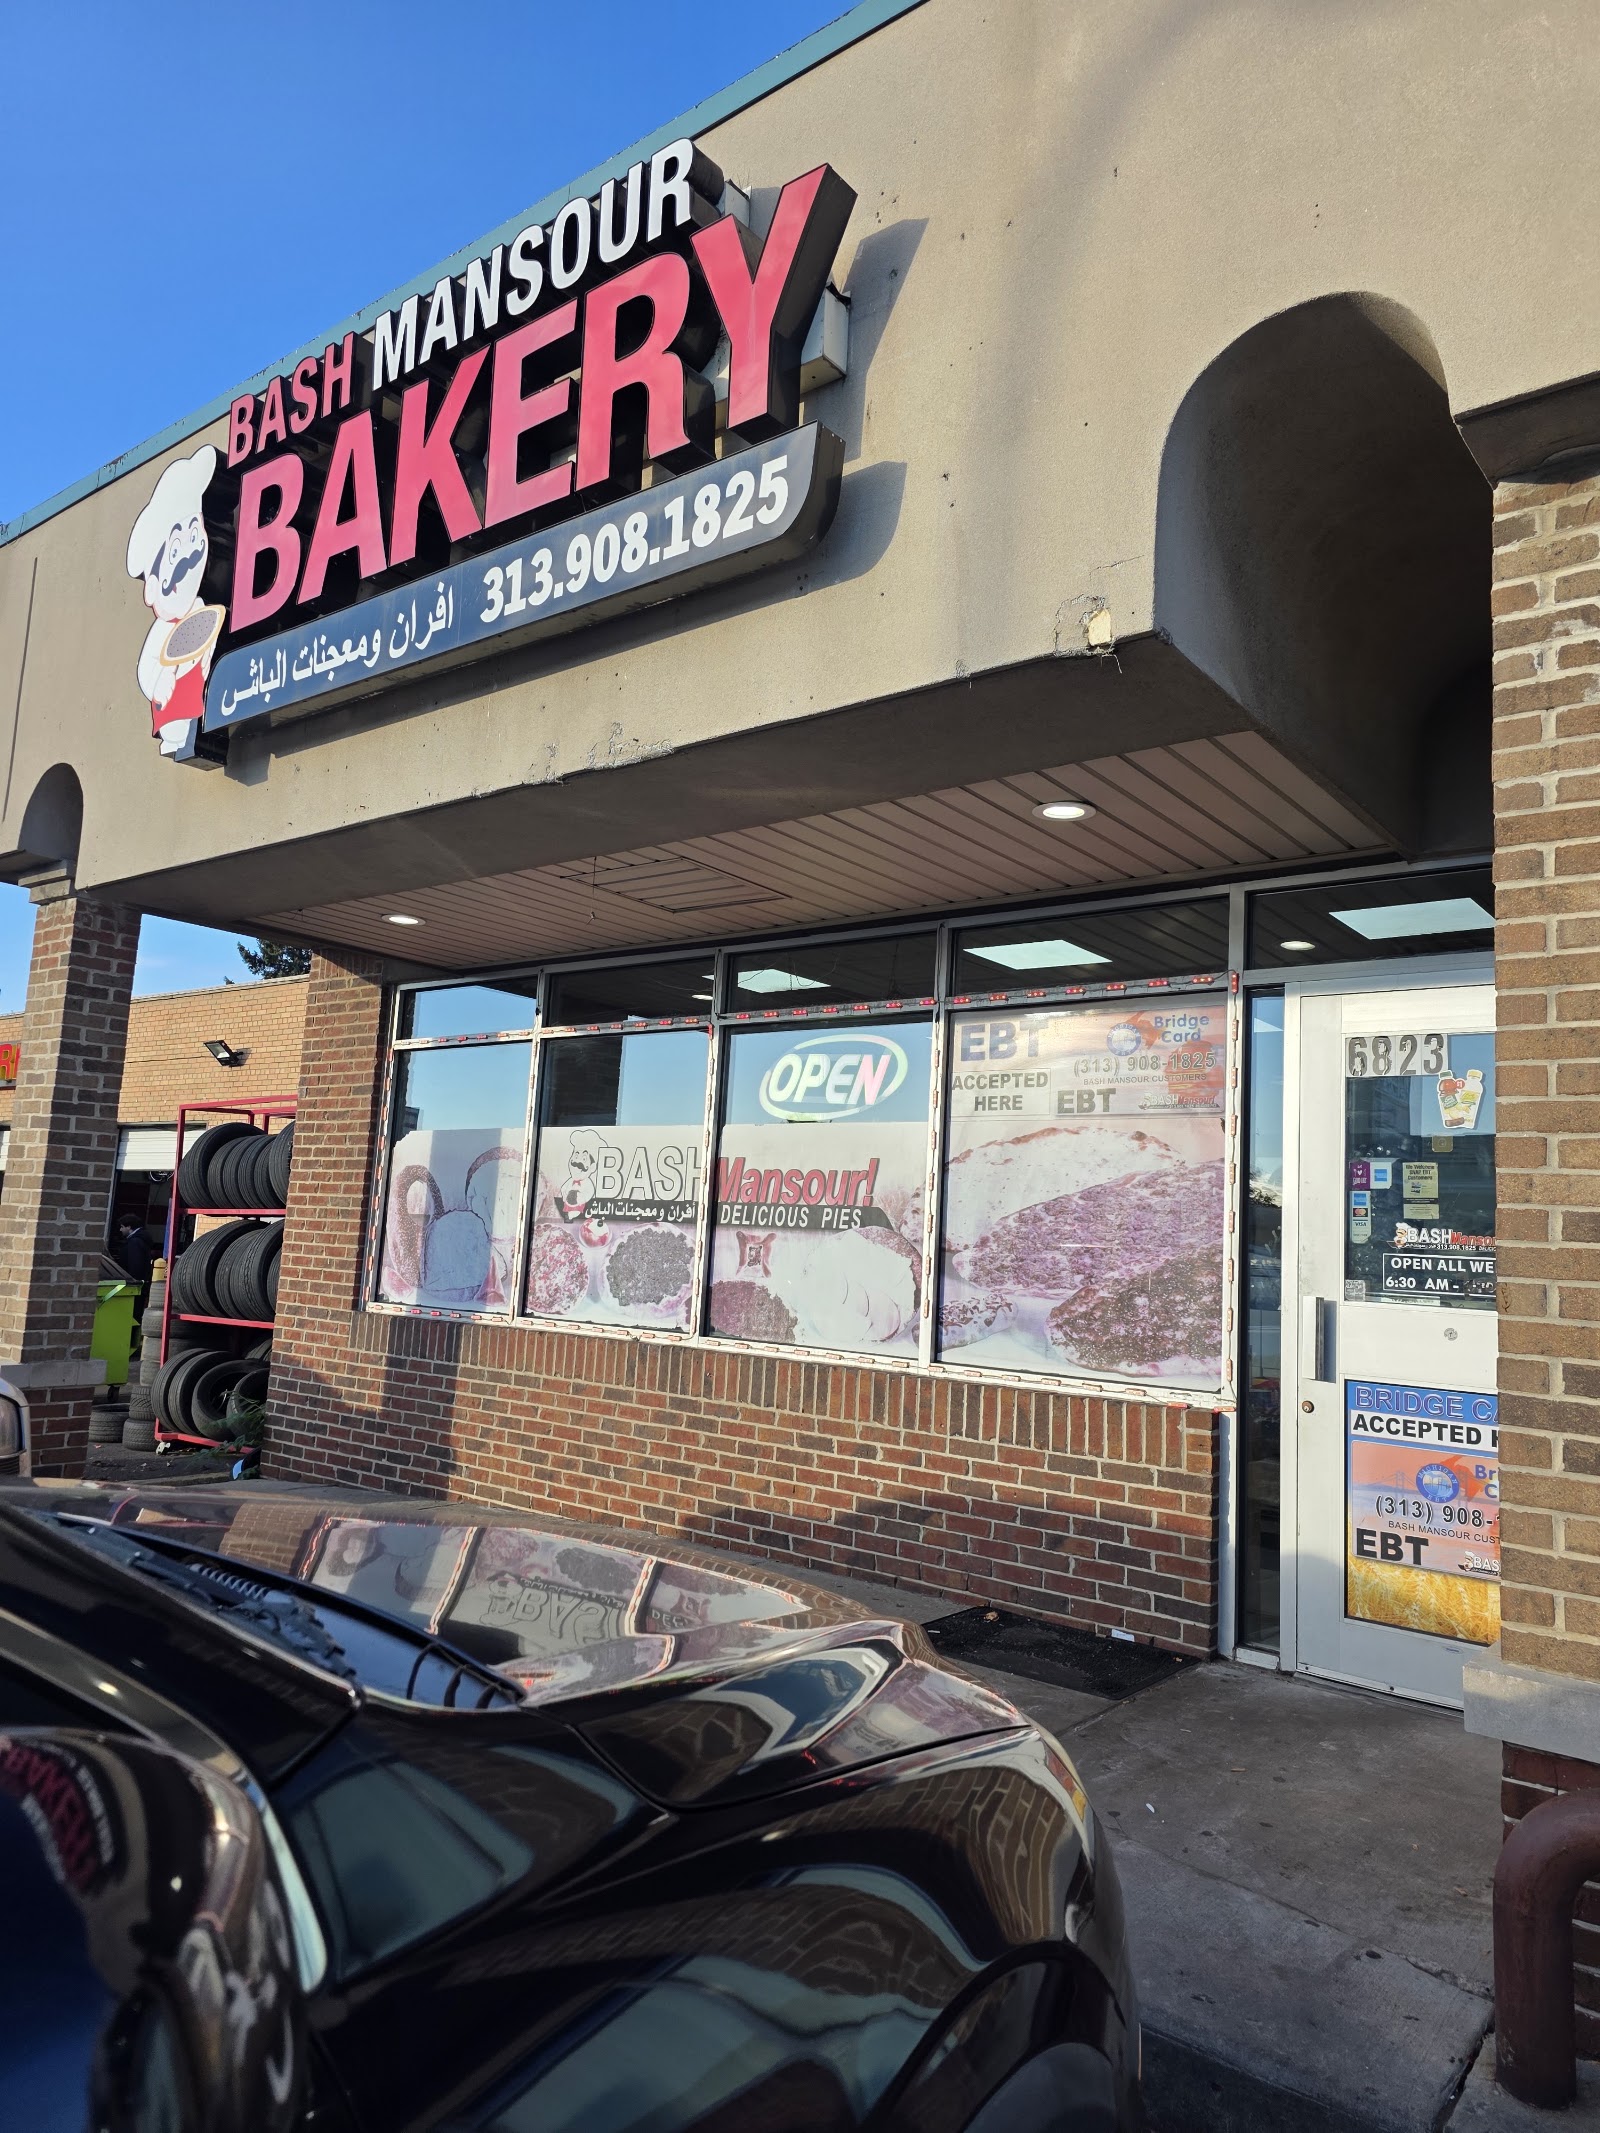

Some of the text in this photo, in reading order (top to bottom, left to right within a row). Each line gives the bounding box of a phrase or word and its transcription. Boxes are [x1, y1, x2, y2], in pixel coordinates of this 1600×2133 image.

[227, 137, 694, 468] BASH MANSOUR
[229, 164, 829, 633] BAKERY
[480, 454, 789, 623] 313.908.1825
[1154, 1014, 1209, 1029] Bridge
[961, 1021, 1049, 1061] EBT
[1162, 1028, 1200, 1043] Card
[1074, 1052, 1216, 1077] (313) 908-1825
[1349, 1034, 1443, 1076] 6823
[769, 1053, 892, 1105] OPEN
[952, 1072, 1048, 1090] ACCEPTED
[1108, 1076, 1149, 1084] MANSOUR
[1152, 1074, 1207, 1082] CUSTOMERS
[974, 1095, 1023, 1112] HERE
[1057, 1088, 1116, 1114] EBT
[1153, 1094, 1178, 1105] BASH
[596, 1146, 880, 1207] BASH Mansour!
[720, 1205, 862, 1229] DELICIOUS PIES
[1407, 1227, 1453, 1244] BASH
[1391, 1258, 1431, 1270] OPEN
[1437, 1260, 1466, 1272] ALL
[1386, 1276, 1416, 1288] 6:30
[1425, 1278, 1449, 1290] AM
[1355, 1386, 1498, 1423] BRIDGE C
[1353, 1414, 1482, 1445] ACCEPTED
[1375, 1495, 1432, 1524] (313)
[1389, 1521, 1415, 1532] BASH
[1419, 1525, 1470, 1540] MANSOUR
[1356, 1528, 1429, 1566] EBT
